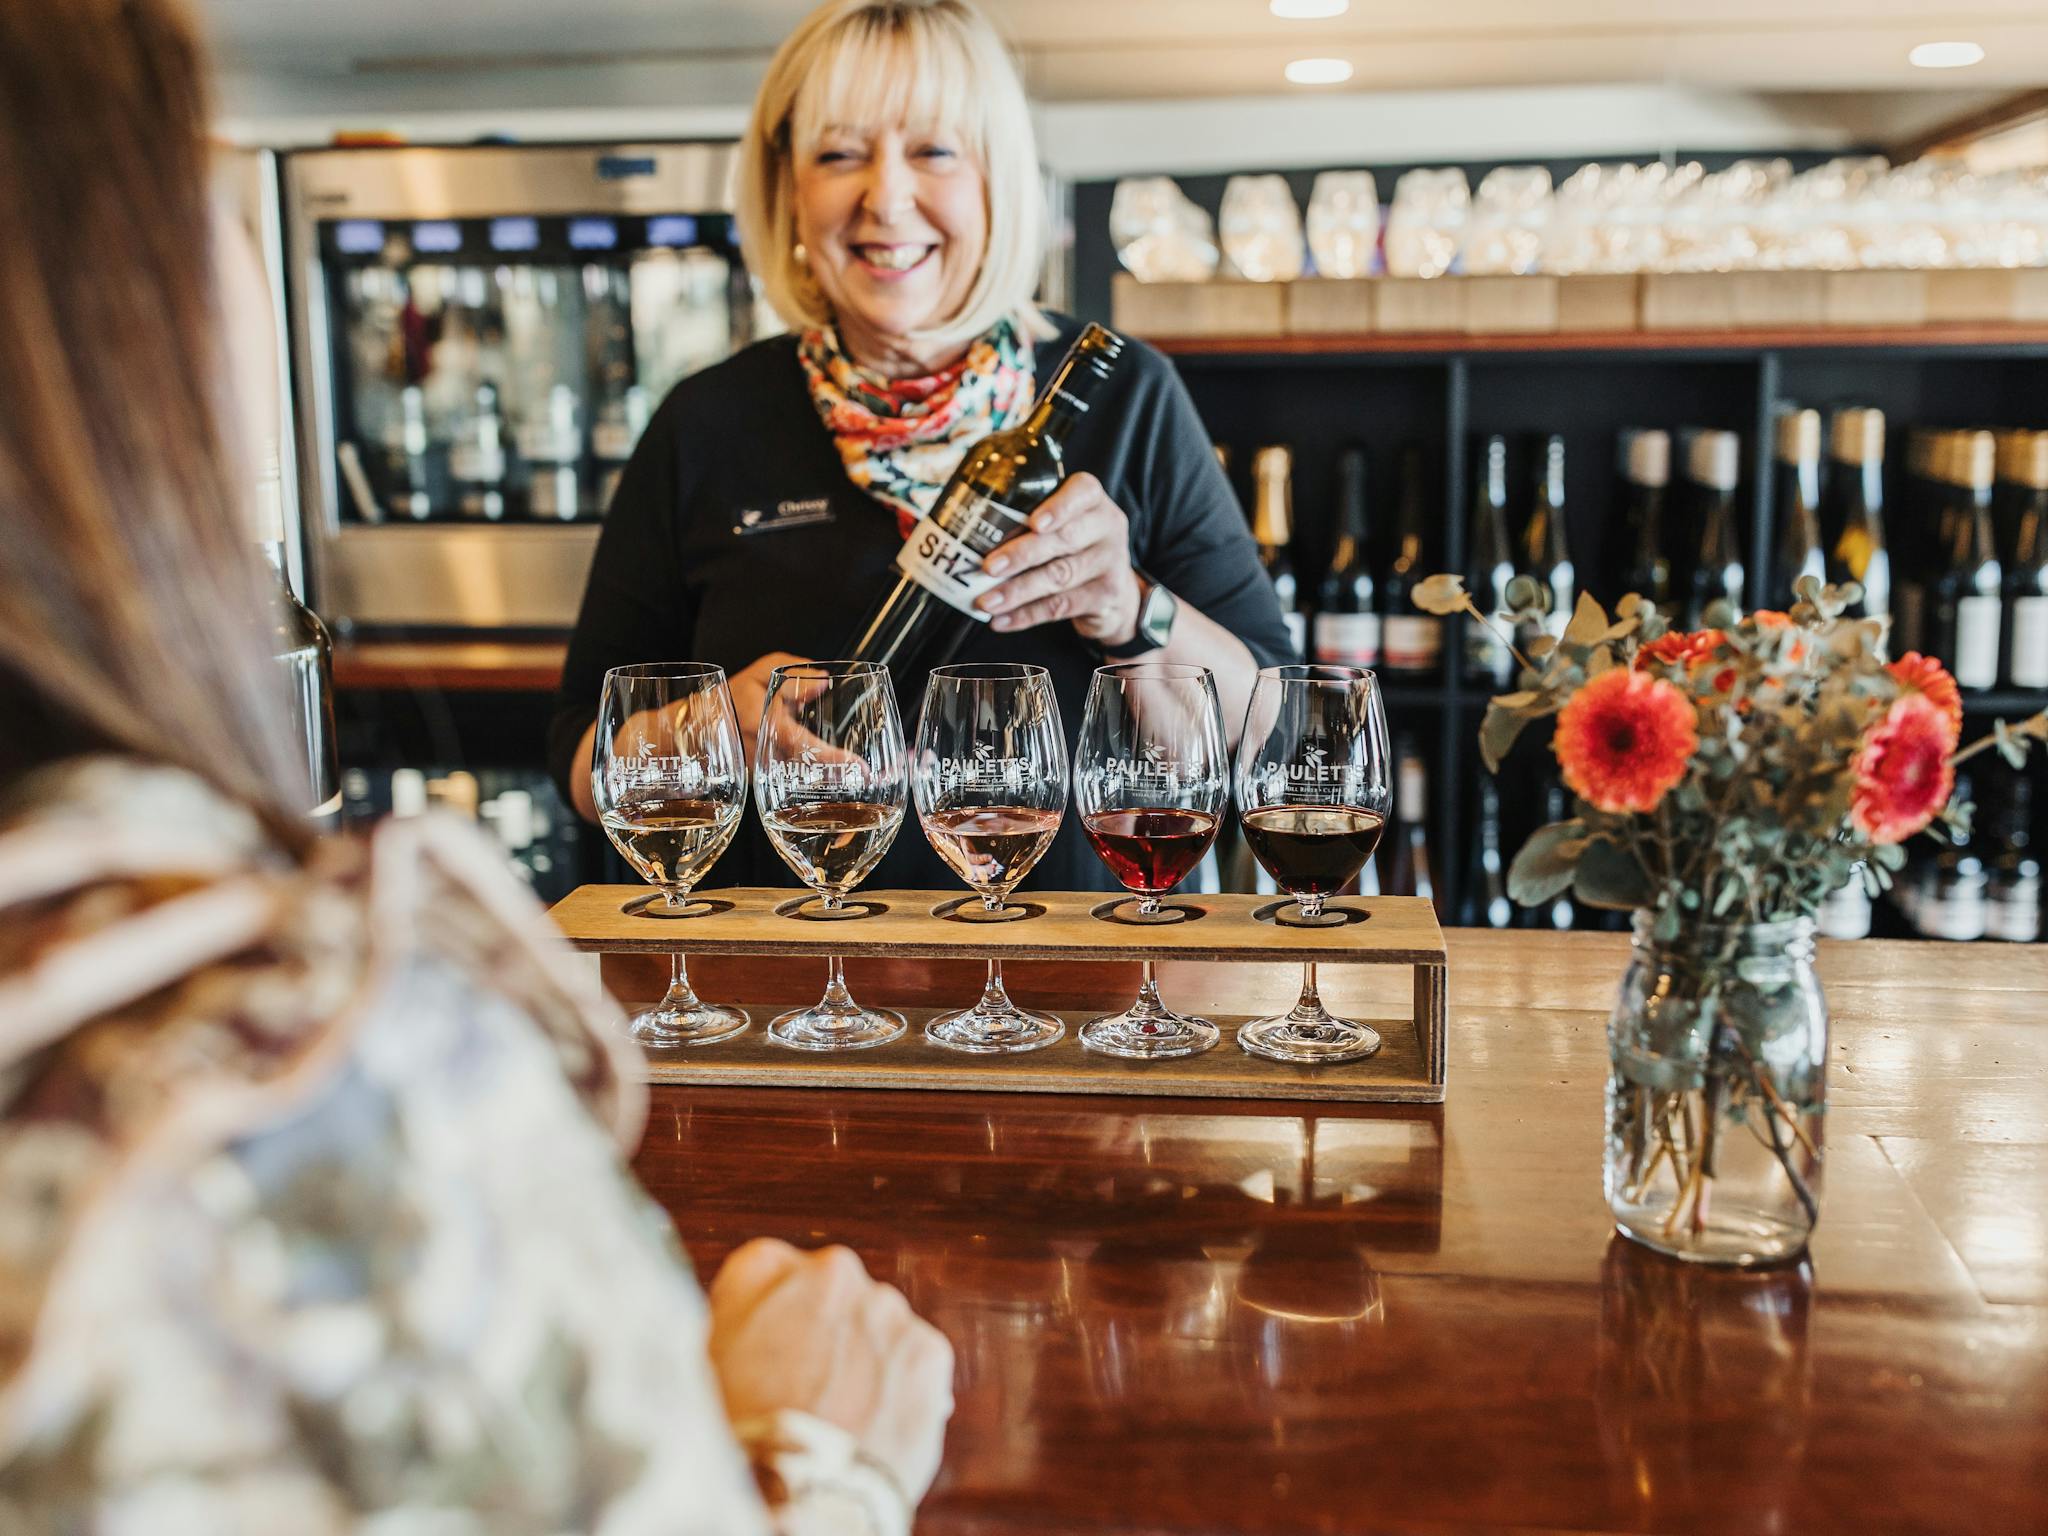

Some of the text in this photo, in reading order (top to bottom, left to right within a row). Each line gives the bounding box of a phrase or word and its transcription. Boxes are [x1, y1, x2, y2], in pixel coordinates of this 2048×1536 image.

[918, 533, 982, 588] SHZ
[942, 757, 1030, 774] PAULETTS
[1106, 757, 1202, 777] PAULETS
[1267, 761, 1365, 781] PAULETTS
